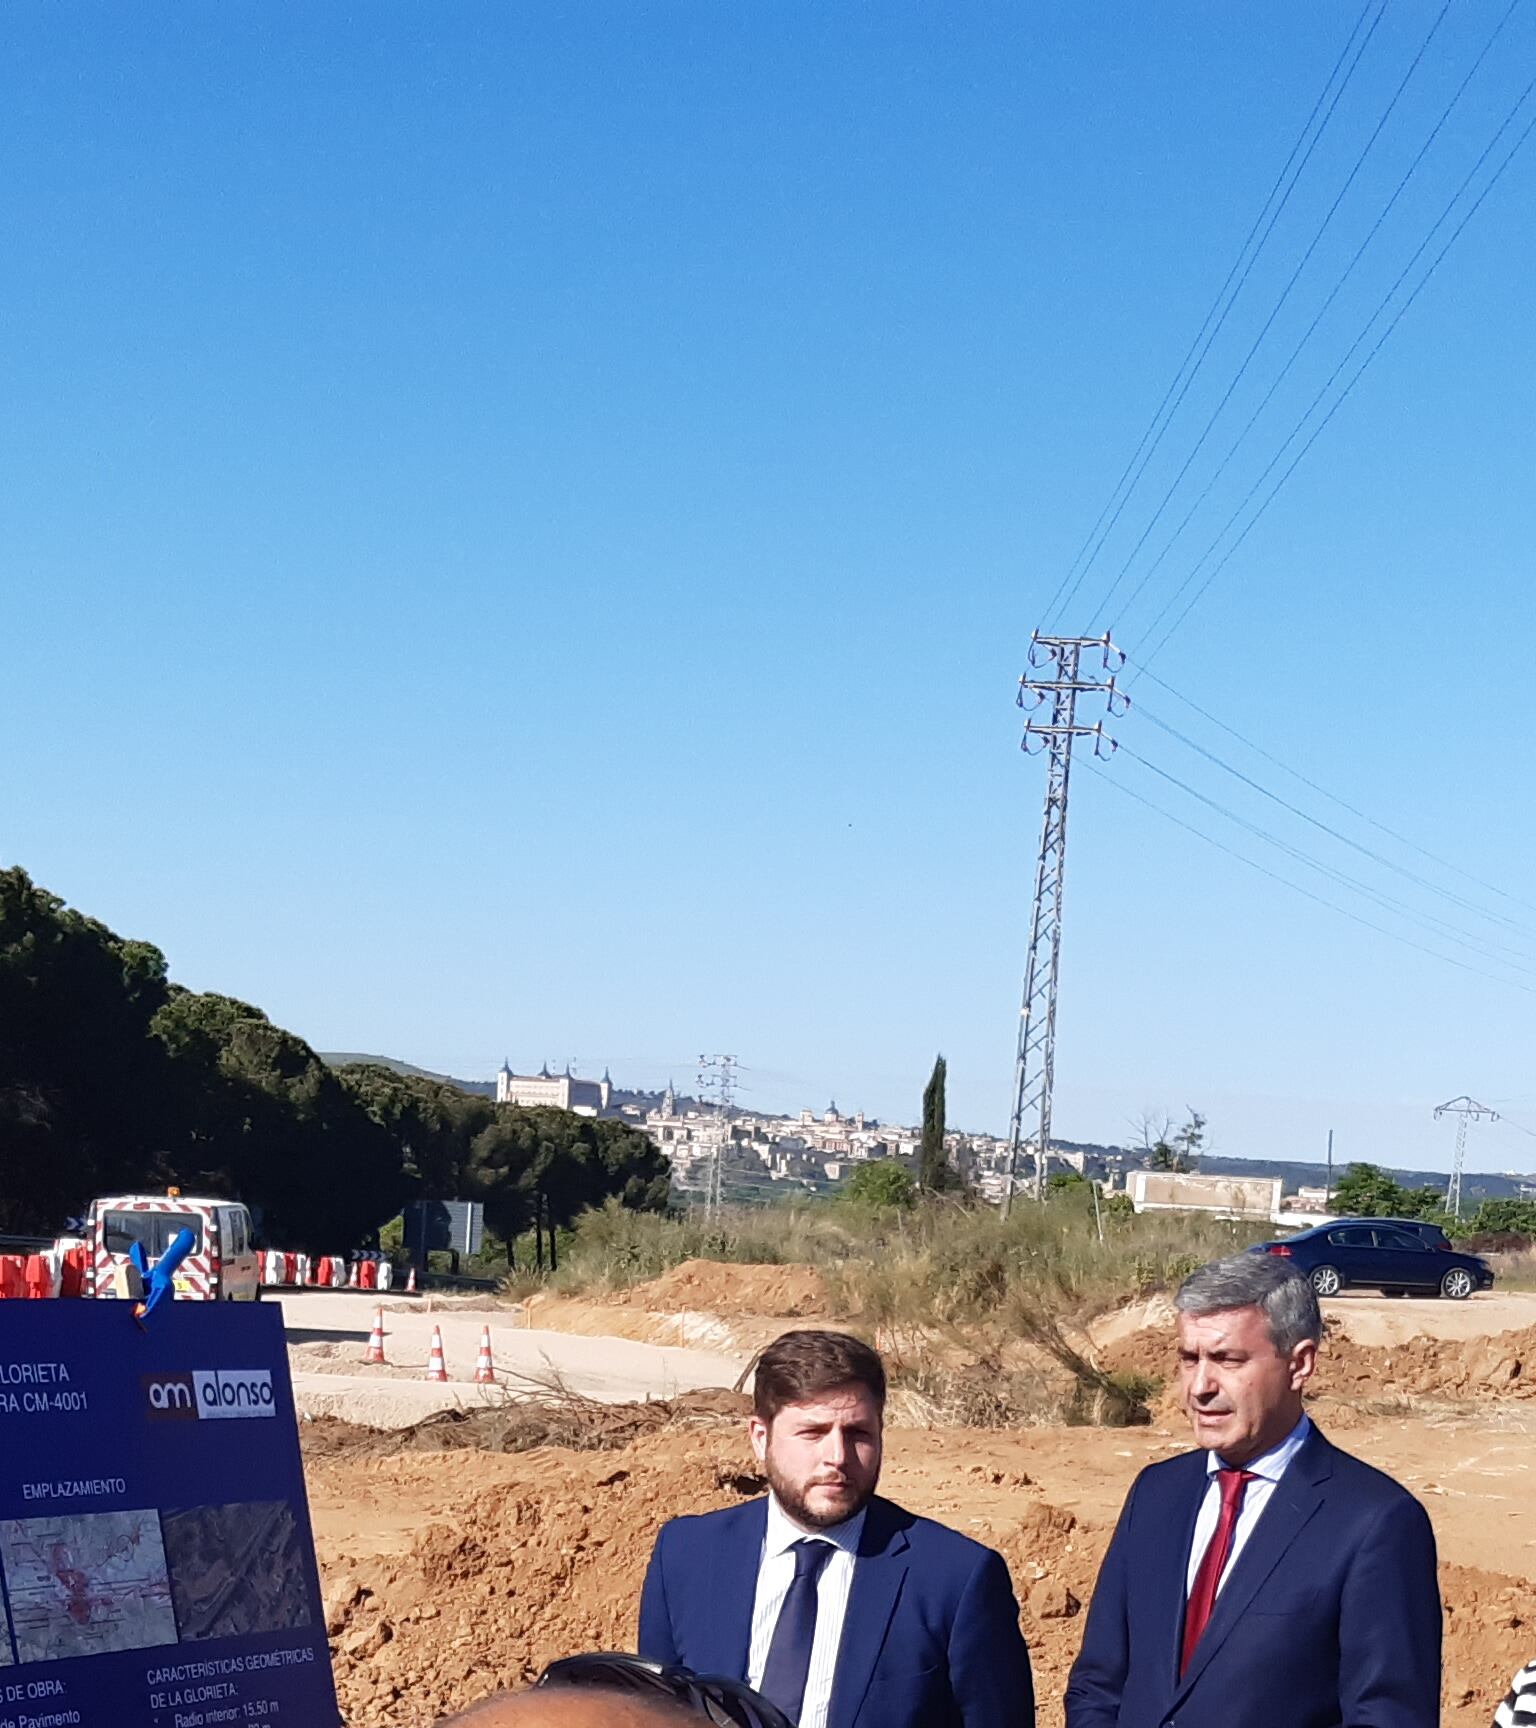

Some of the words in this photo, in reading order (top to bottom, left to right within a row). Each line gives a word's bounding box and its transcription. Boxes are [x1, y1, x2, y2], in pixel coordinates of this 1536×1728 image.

[202, 1371, 273, 1406] alonso
[23, 1391, 87, 1412] CM-4001
[22, 1478, 126, 1499] EMPLAZAMIENTO
[147, 1657, 244, 1685] CARACTERÍSTICAS
[245, 1647, 314, 1670] GEOMÉTRICAS
[6, 1685, 25, 1702] DE
[150, 1692, 167, 1709] DE
[168, 1691, 183, 1706] LA
[174, 1712, 204, 1728] Radio
[270, 1701, 279, 1712] m
